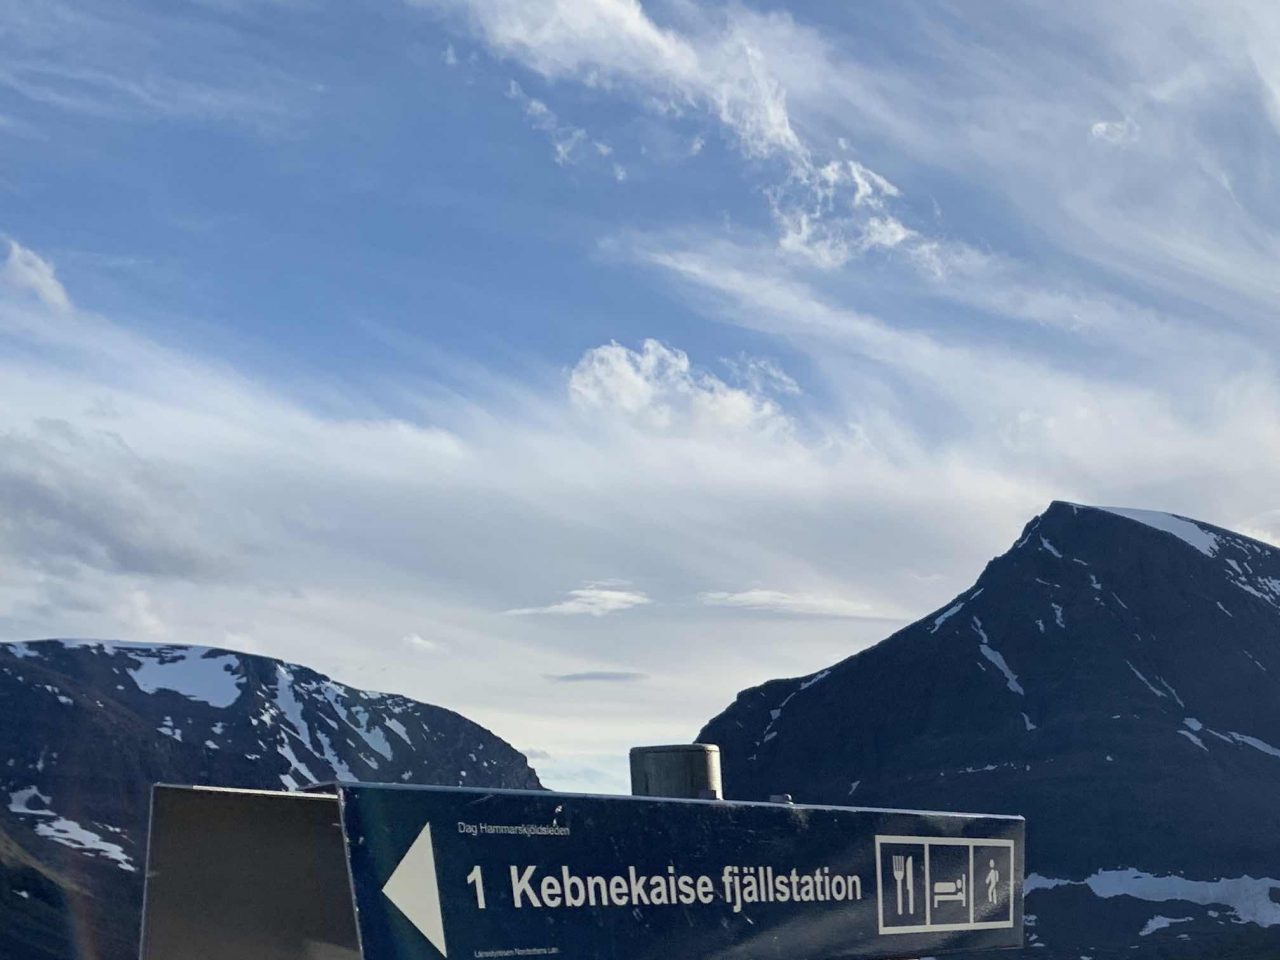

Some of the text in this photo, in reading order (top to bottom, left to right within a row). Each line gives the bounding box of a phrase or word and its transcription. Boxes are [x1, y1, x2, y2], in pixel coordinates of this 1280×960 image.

[458, 822, 477, 835] Dag
[466, 865, 861, 912] 1 Kebnekaise fjällstation
